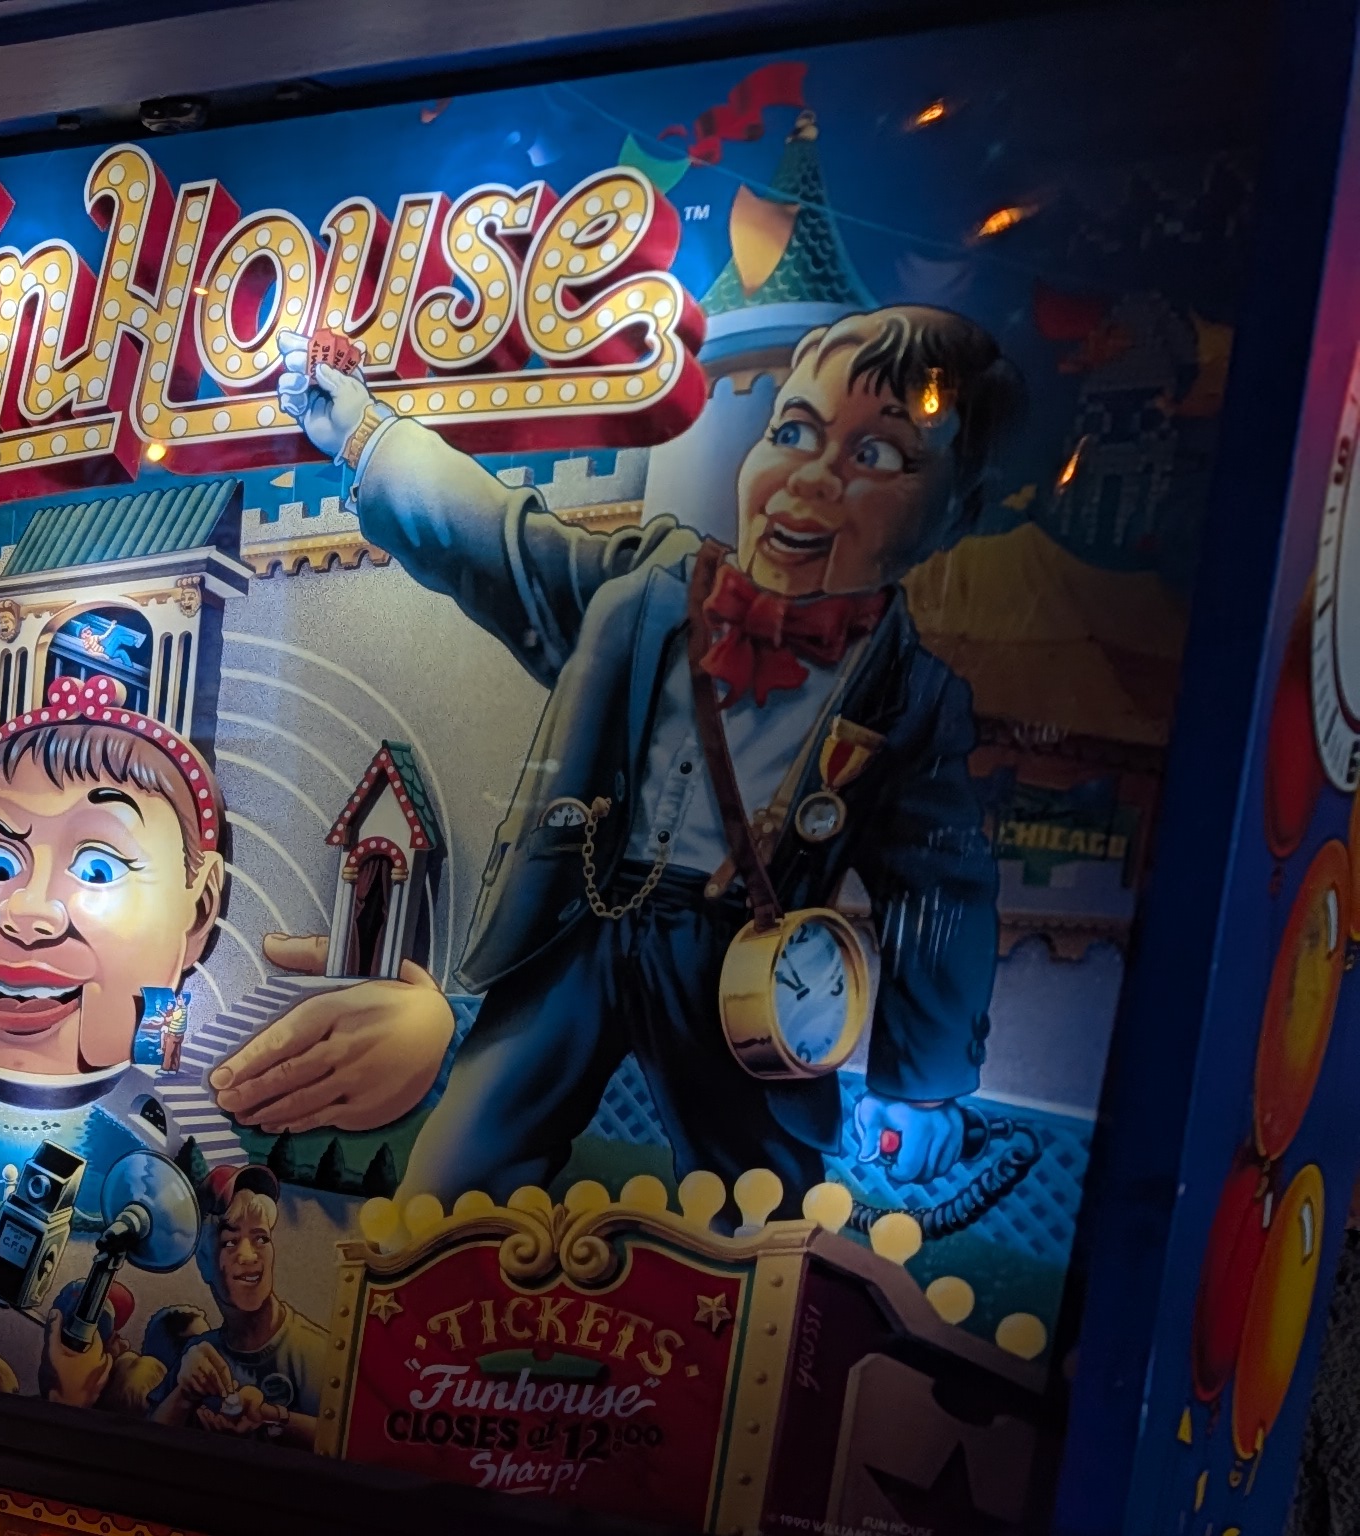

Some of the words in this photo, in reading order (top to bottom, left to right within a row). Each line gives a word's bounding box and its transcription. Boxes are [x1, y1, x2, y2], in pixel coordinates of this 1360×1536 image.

[683, 205, 711, 221] TM
[322, 346, 331, 361] NE
[427, 1296, 685, 1376] TICKETS
[386, 1410, 521, 1452] CLOSES
[527, 1419, 559, 1453] at
[564, 1422, 664, 1465] 12:00
[469, 1449, 588, 1495] Sharp!
